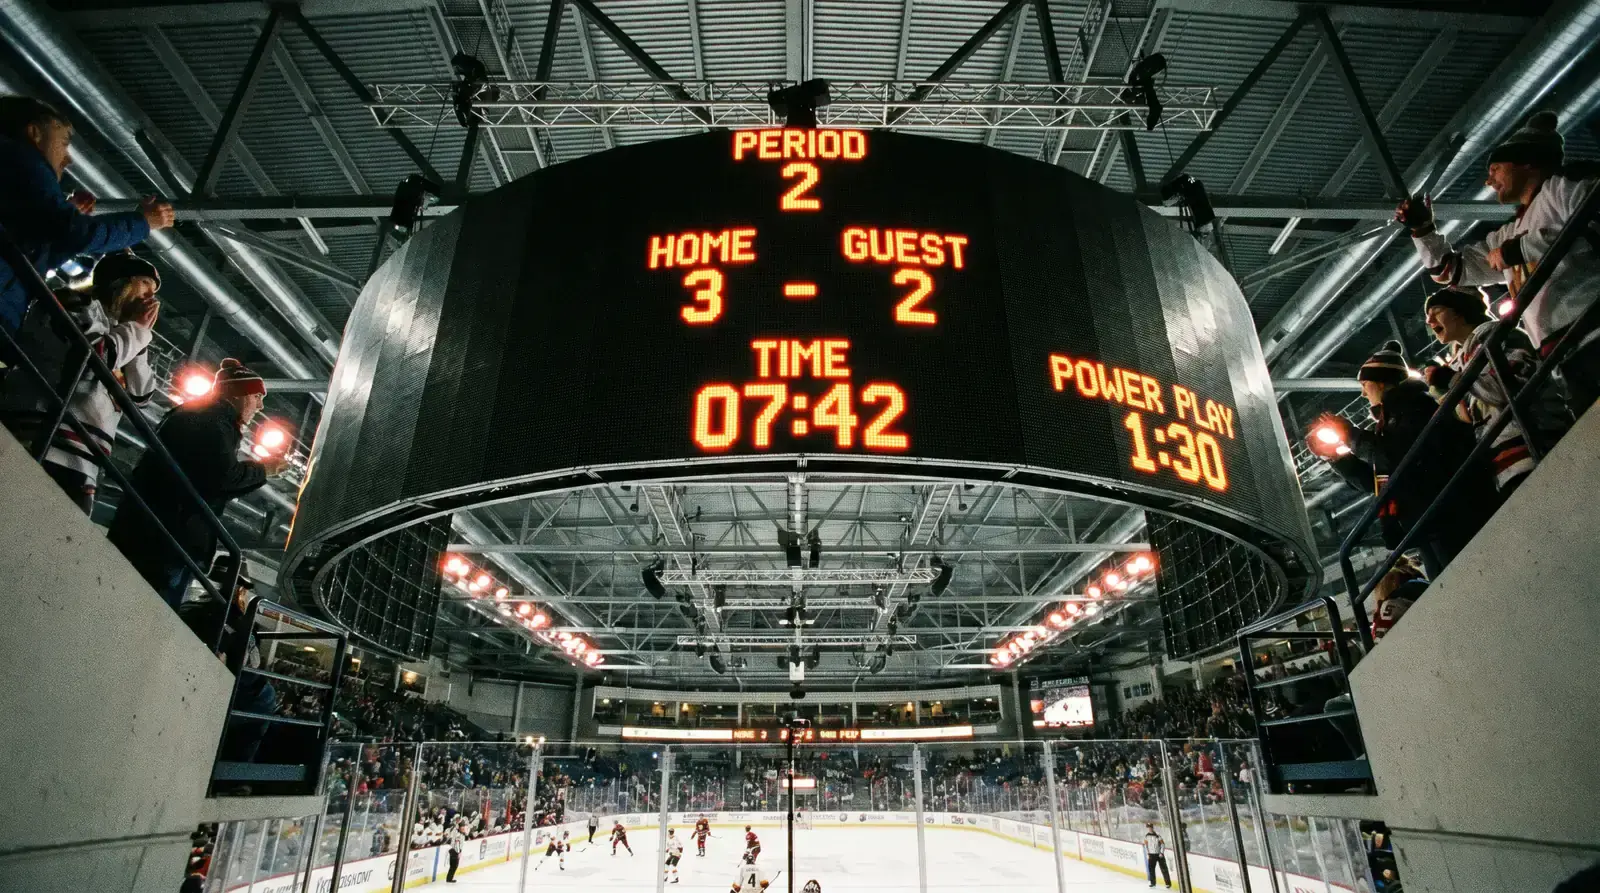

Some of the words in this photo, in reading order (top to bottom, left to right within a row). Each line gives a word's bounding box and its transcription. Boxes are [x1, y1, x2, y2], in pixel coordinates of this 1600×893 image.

[733, 127, 866, 160] PERIOD
[781, 163, 820, 210] 2
[649, 229, 756, 269] HOME
[843, 228, 967, 270] GUEST
[682, 269, 724, 323] 3
[784, 283, 817, 297] -
[894, 269, 936, 324] 2
[752, 339, 850, 379] TIME
[693, 383, 909, 450] 07:42
[1050, 354, 1166, 415] POWER
[1172, 385, 1235, 440] PLAY
[1124, 411, 1229, 491] 1:30
[747, 873, 756, 888] 4
